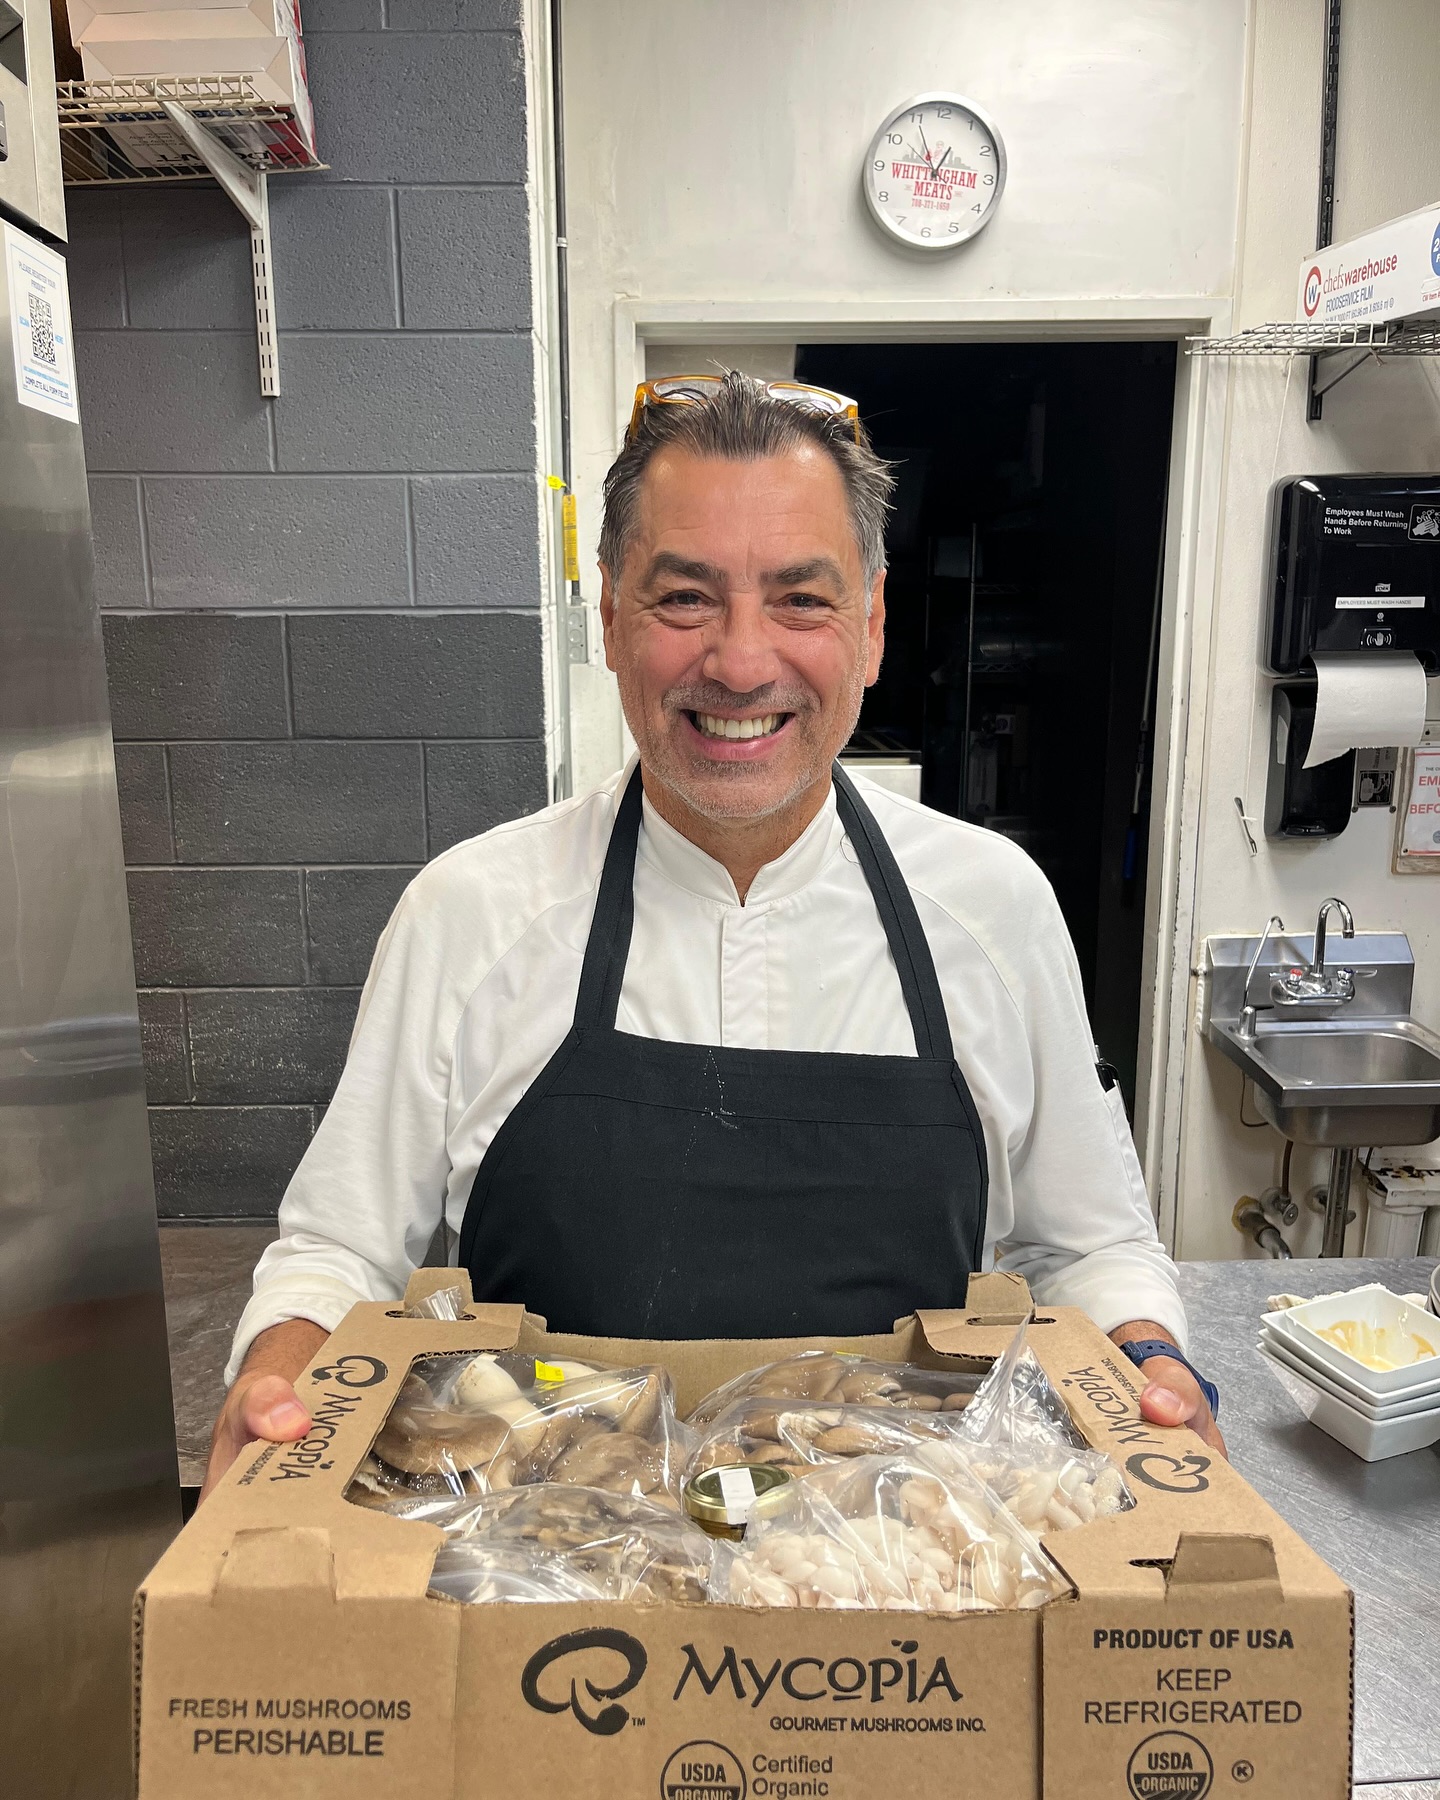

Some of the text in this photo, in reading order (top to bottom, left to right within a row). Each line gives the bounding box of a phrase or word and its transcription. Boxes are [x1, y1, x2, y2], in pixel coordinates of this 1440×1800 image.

[910, 113, 923, 124] 11
[936, 107, 952, 119] 12
[886, 134, 902, 145] 10
[980, 146, 991, 157] 2
[874, 160, 885, 171] 9
[892, 163, 978, 189] WHITTINGHAM
[983, 175, 994, 186] 3
[878, 191, 888, 202] 8
[913, 182, 953, 200] MEATS
[971, 204, 982, 214] 4
[896, 215, 907, 226] 7
[920, 227, 931, 238] 6
[948, 222, 959, 234] 5
[1326, 285, 1374, 313] FOODSERVICE FILM
[1326, 507, 1364, 518] Employees
[1348, 518, 1372, 527] Before
[1373, 520, 1408, 530] Returning
[1419, 776, 1440, 786] EM
[1093, 1629, 1294, 1649] PRODUCT OF USA
[1156, 1668, 1232, 1691] KEEP
[169, 1698, 412, 1720] FRESH MUSHROOMS
[1084, 1701, 1302, 1724] REFRIGERATED
[770, 1717, 846, 1731] GOURMET
[850, 1717, 952, 1731] MUSHROOMS
[193, 1729, 384, 1756] PERISHABLE
[752, 1754, 832, 1773] Certified
[1148, 1752, 1193, 1770] USDA
[681, 1763, 726, 1783] USDA
[752, 1778, 829, 1800] Organic
[1141, 1776, 1199, 1791] ORGANIC
[674, 1789, 732, 1800] ORGANIC
